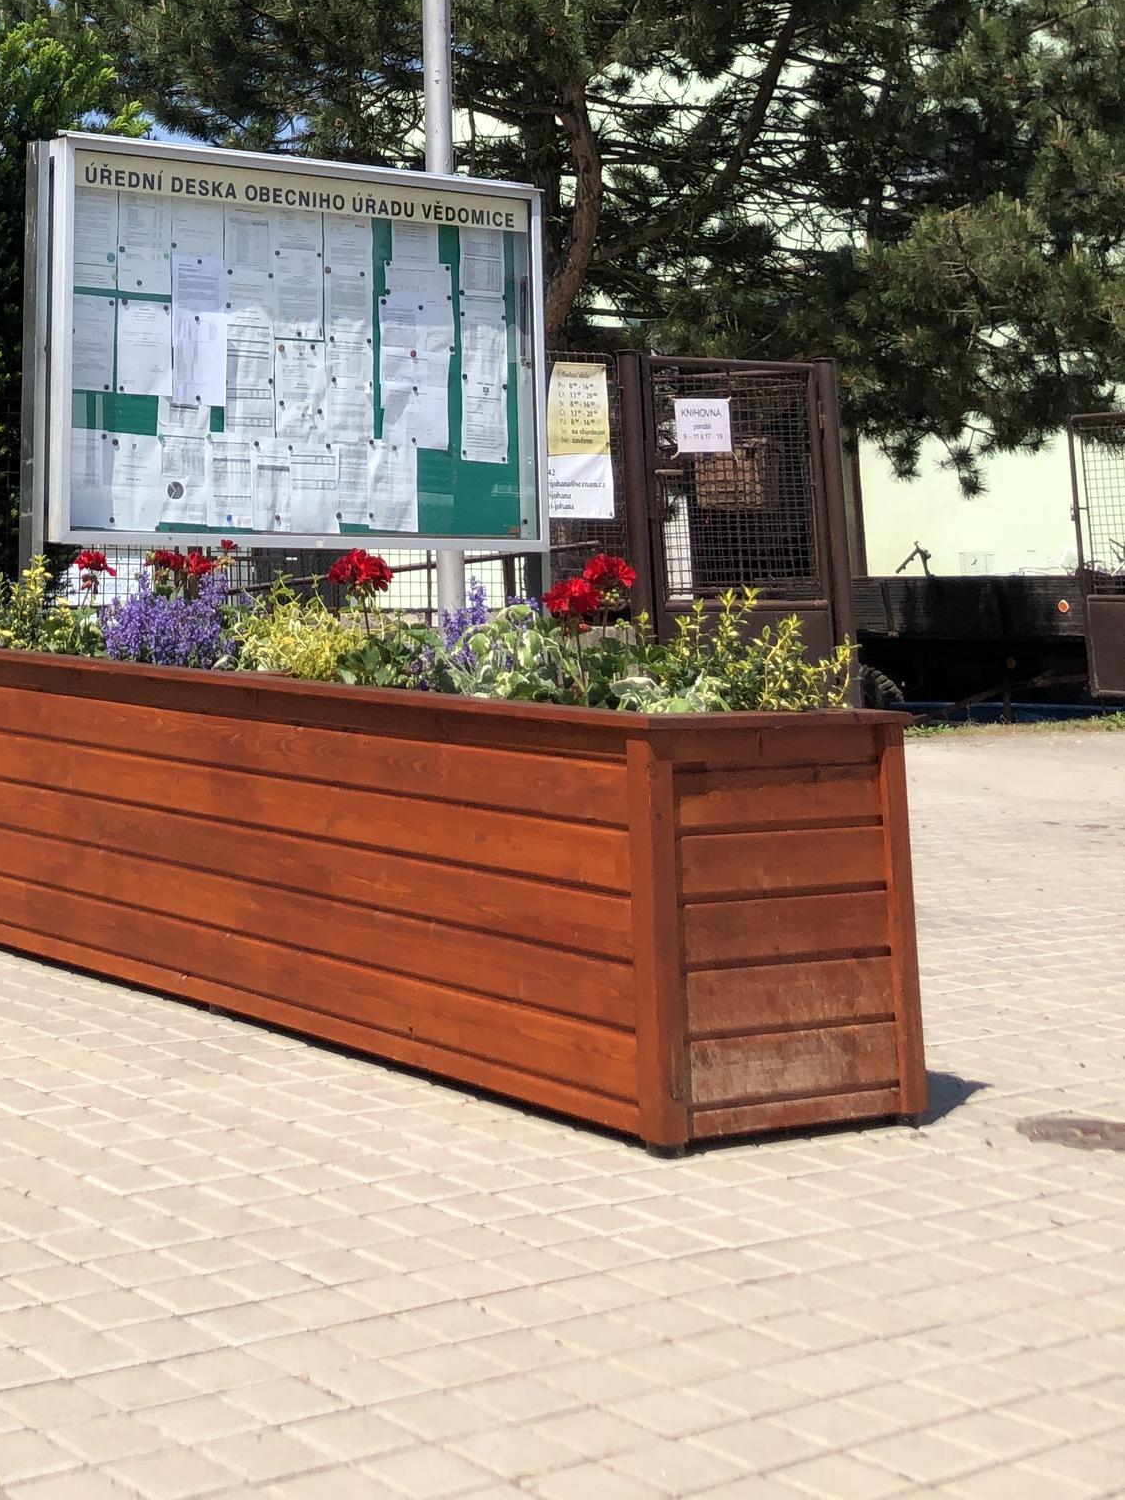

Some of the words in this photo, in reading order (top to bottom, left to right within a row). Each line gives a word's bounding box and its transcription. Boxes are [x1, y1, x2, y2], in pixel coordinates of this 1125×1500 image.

[85, 162, 163, 191] ÚŘEDNÍ
[171, 176, 236, 199] DESKA
[245, 184, 345, 211] OBECNIHO
[352, 192, 415, 217] ÚŘADU
[421, 200, 514, 228] VĚDOMICE
[681, 408, 722, 417] KNIHOVNA
